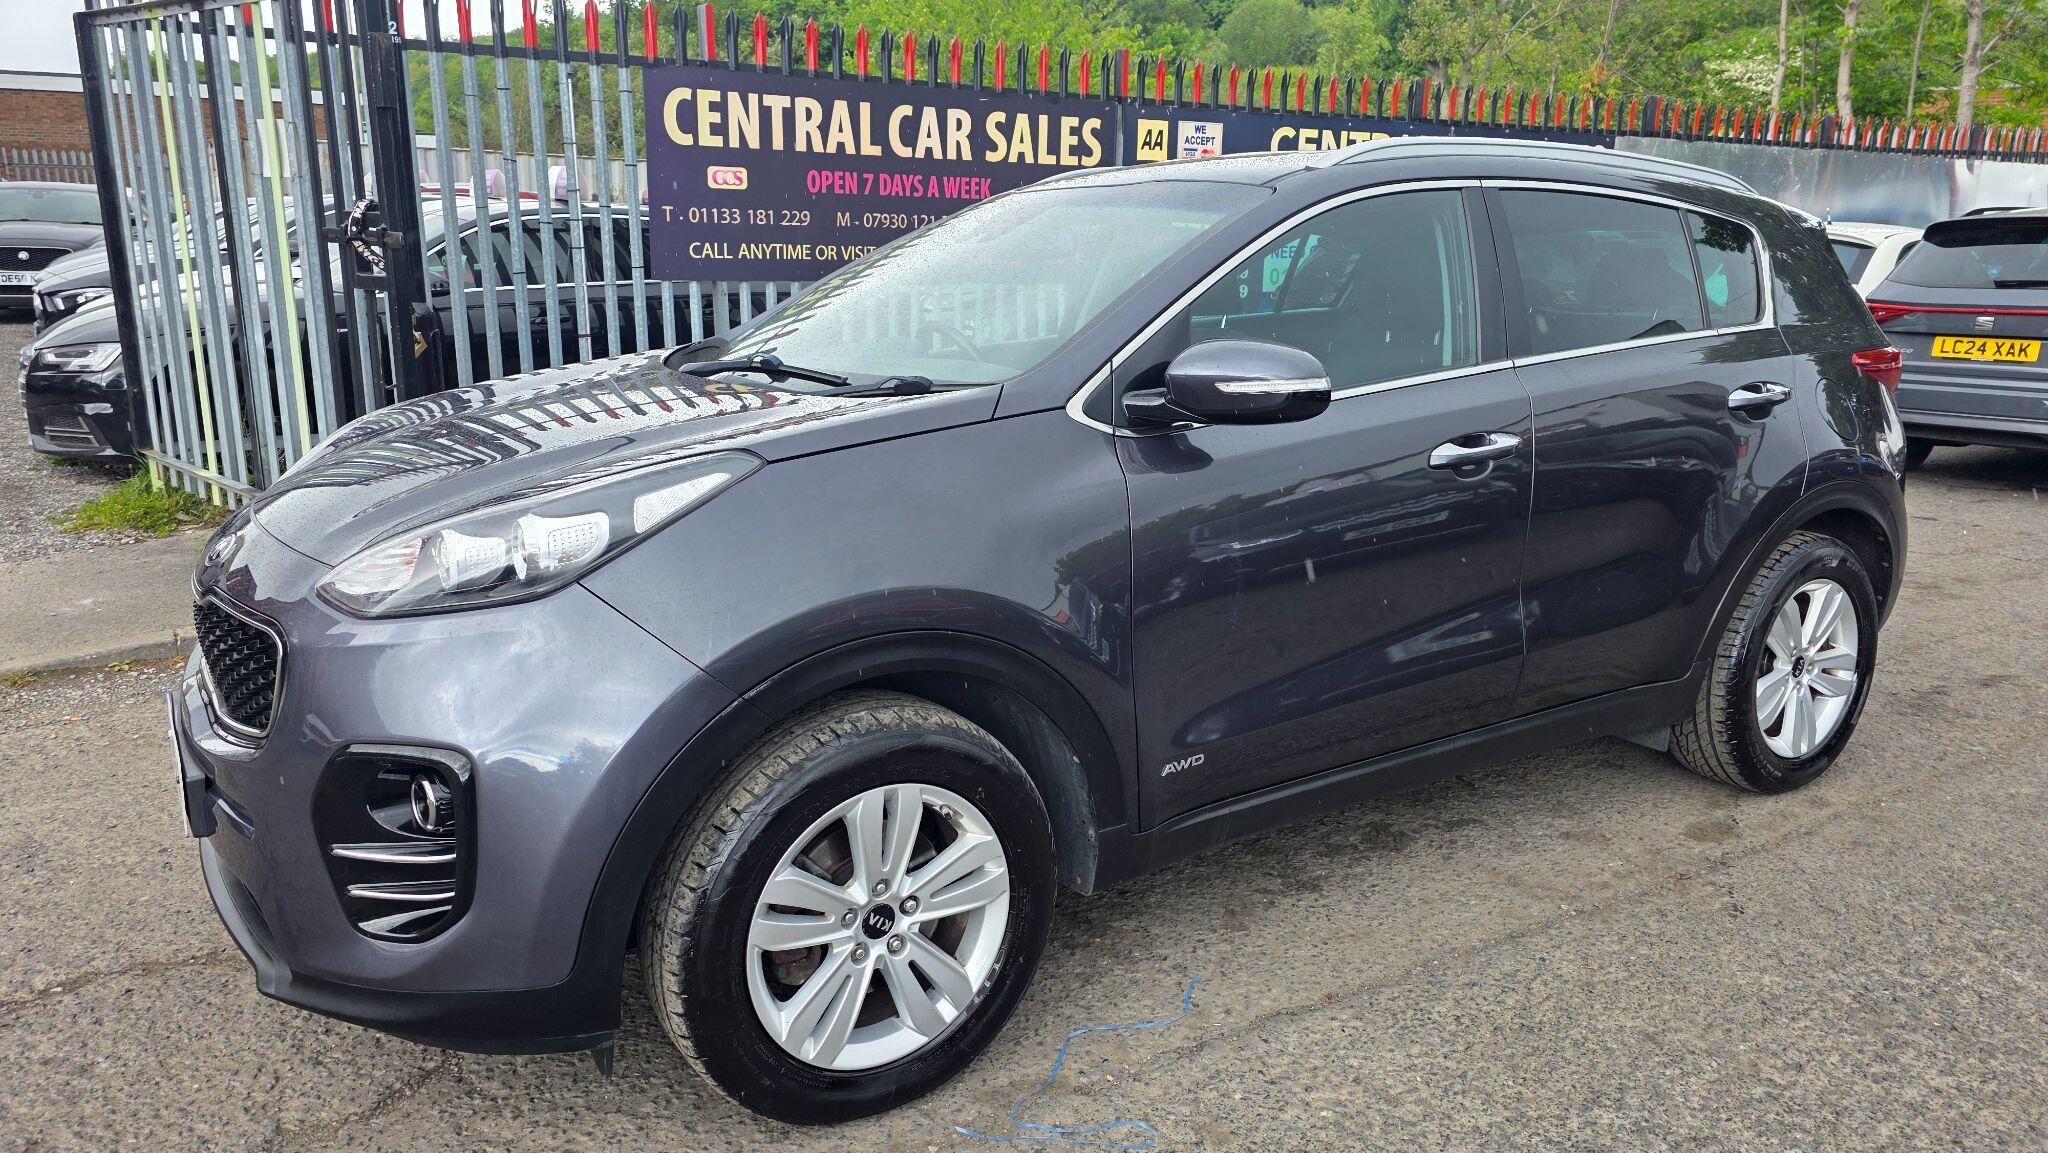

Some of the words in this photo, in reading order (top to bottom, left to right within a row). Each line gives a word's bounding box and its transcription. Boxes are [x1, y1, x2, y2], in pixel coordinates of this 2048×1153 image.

[663, 86, 882, 157] CENTRAL
[888, 104, 973, 162] CAR
[984, 111, 1103, 168] SALES
[1194, 124, 1207, 135] WE
[1140, 128, 1164, 151] AA
[1184, 135, 1216, 146] ACCEPT
[807, 169, 858, 195] OPEN
[862, 173, 875, 195] 7
[879, 173, 924, 198] DAYS
[927, 175, 940, 199] A
[943, 176, 992, 200] WEEK
[688, 207, 742, 224] 01133
[747, 208, 775, 225] 181
[781, 210, 811, 226] 229
[863, 212, 907, 229] 07930
[689, 241, 734, 260] CALL
[737, 243, 812, 261] ANYTIME
[815, 245, 838, 261] OR
[1940, 339, 1987, 356] LC24
[1992, 341, 2032, 358] XAK
[1161, 753, 1205, 777] AWD
[868, 911, 893, 932] KIA
